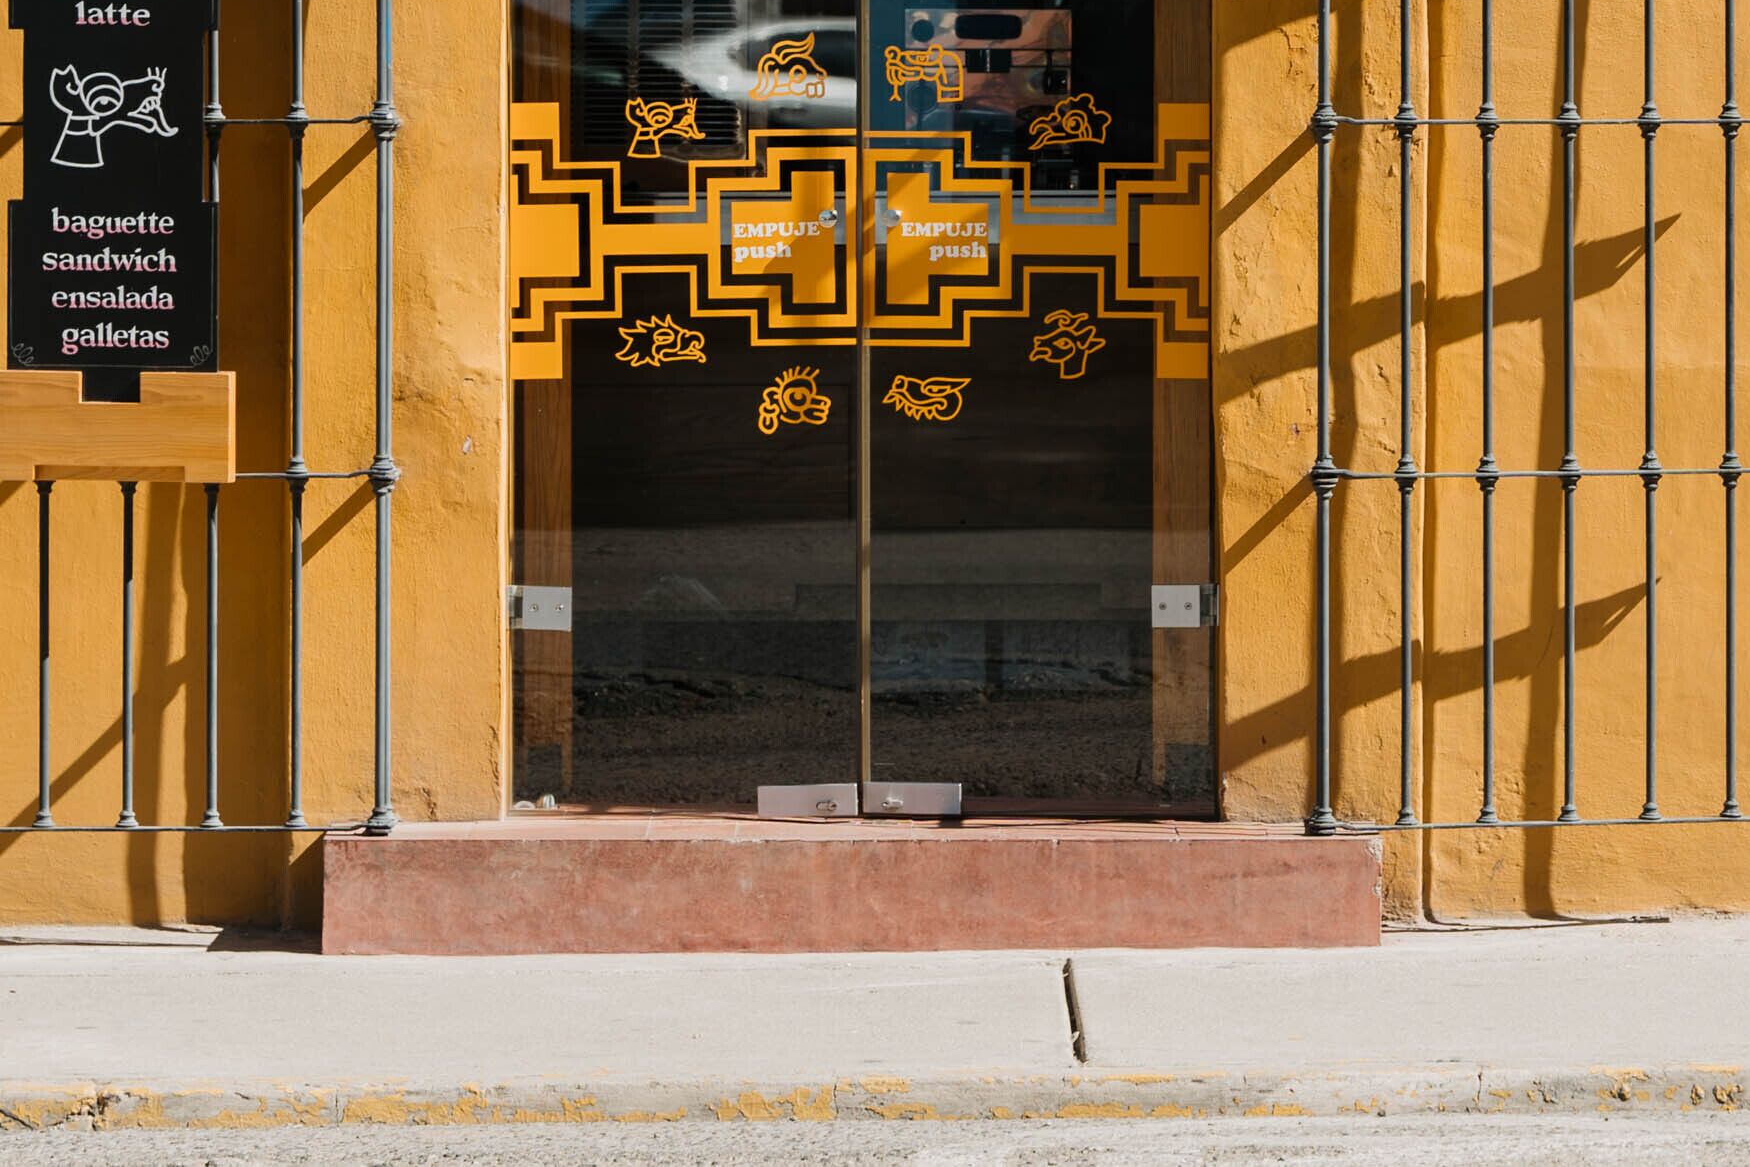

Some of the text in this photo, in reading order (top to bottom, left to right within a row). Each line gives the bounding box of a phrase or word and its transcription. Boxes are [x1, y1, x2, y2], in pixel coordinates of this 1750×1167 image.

[75, 0, 151, 27] latte
[51, 206, 175, 239] baguette
[733, 222, 820, 238] EMPUJE
[901, 222, 987, 237] EMPUJE
[42, 246, 177, 273] sandwich
[734, 242, 792, 263] push
[929, 241, 986, 261] push
[51, 284, 175, 311] ensalada
[61, 322, 170, 355] galletas
